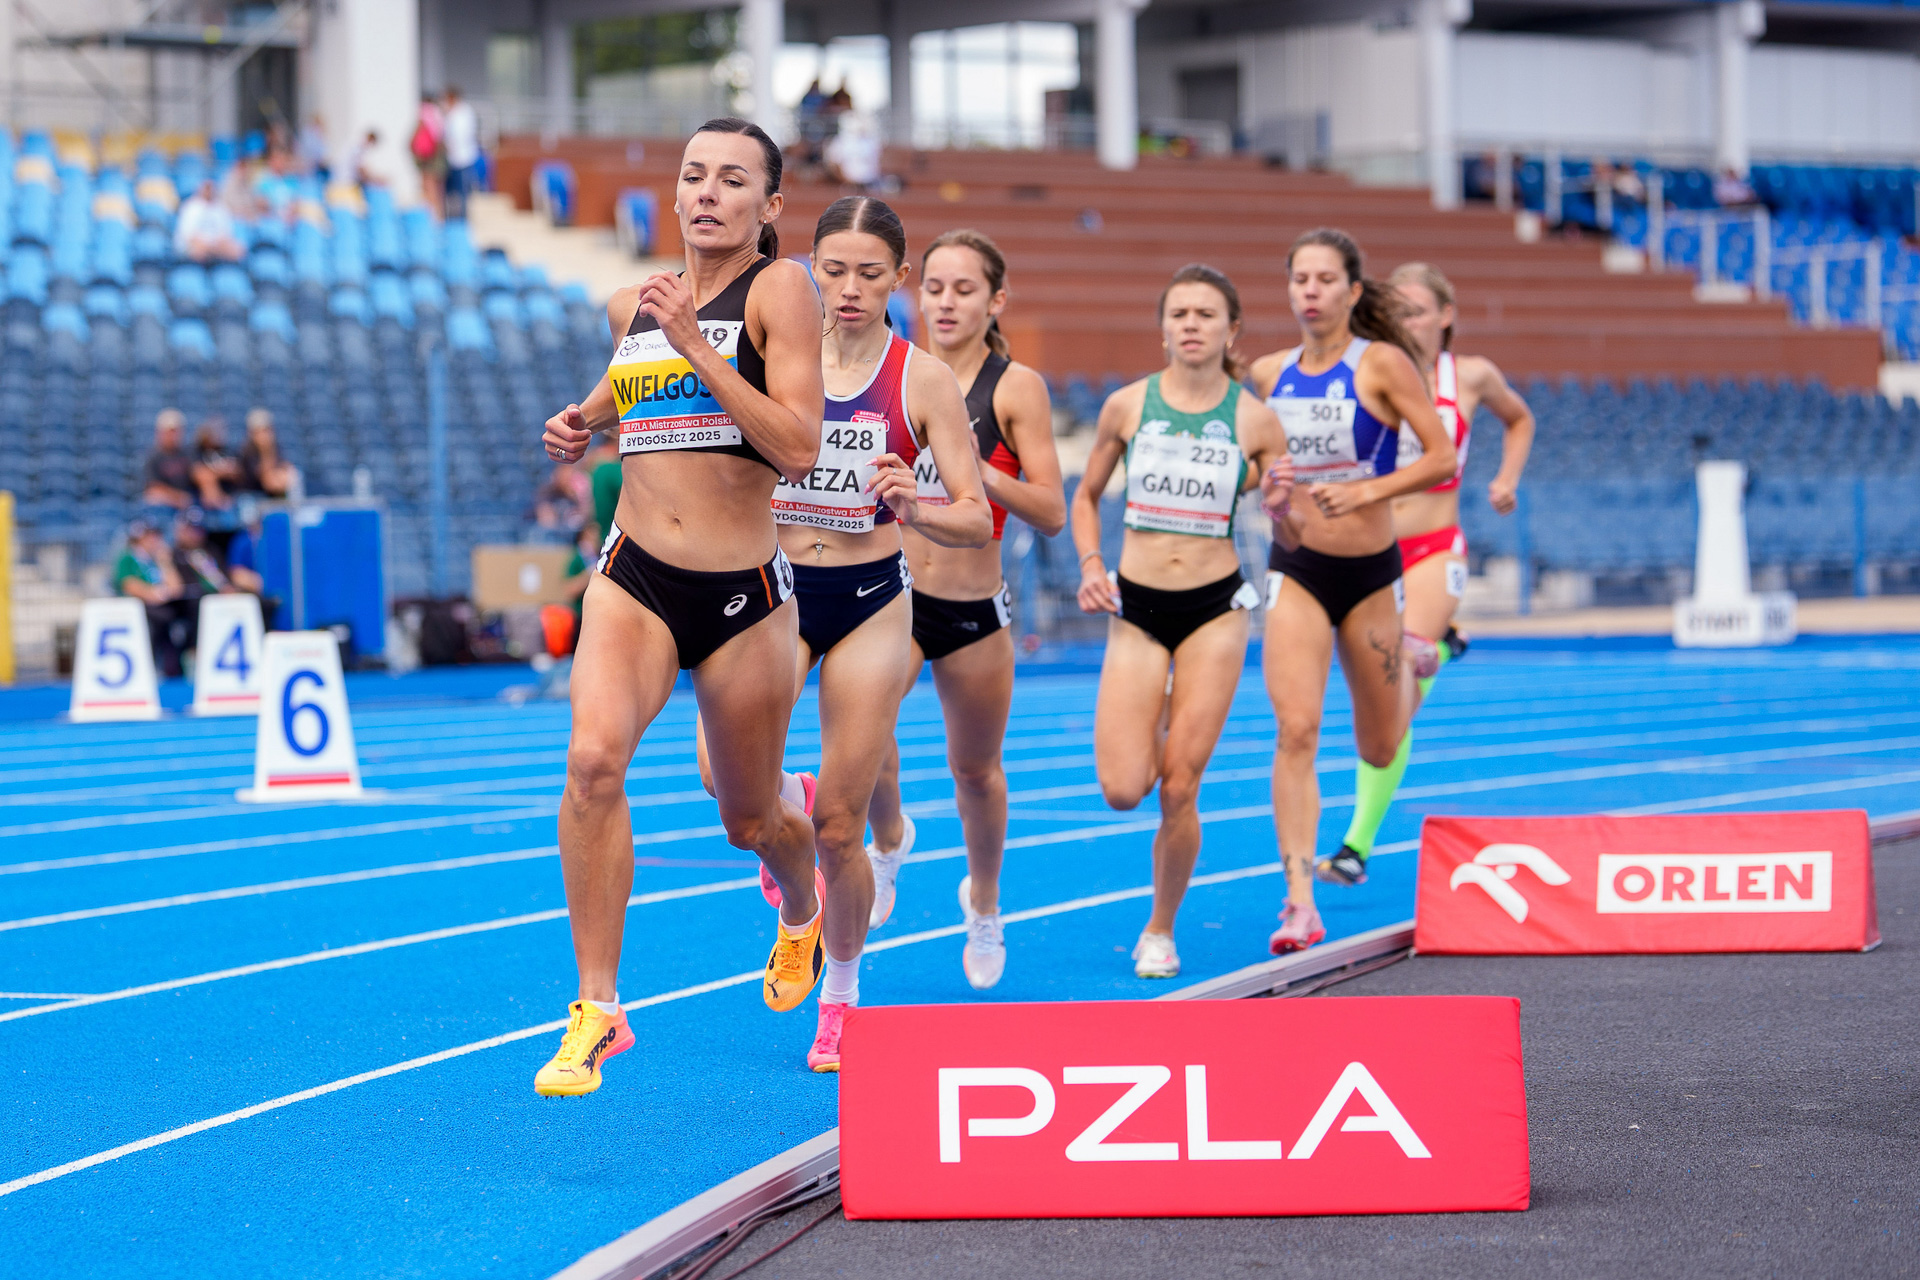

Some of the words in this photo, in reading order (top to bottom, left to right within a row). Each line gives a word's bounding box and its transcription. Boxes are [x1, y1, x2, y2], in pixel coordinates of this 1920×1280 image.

[631, 421, 648, 431] PZLA
[649, 417, 699, 430] Mistrzostwa
[1310, 404, 1343, 421] 501
[626, 433, 687, 447] BYDGOSZCZ
[689, 430, 721, 441] 2025
[826, 428, 874, 450] 428
[1287, 432, 1339, 455] OPEĆ
[1191, 446, 1229, 467] 223
[1142, 473, 1216, 500] GAJDA
[774, 500, 794, 510] PZLA
[796, 503, 847, 516] Mistrzostwa
[837, 520, 865, 529] 2025
[96, 627, 133, 688] 5
[213, 622, 251, 682] 4
[282, 670, 330, 757] 6
[1613, 863, 1814, 902] ORLEN
[581, 1026, 616, 1076] NITRO
[938, 1061, 1432, 1163] PZLA
